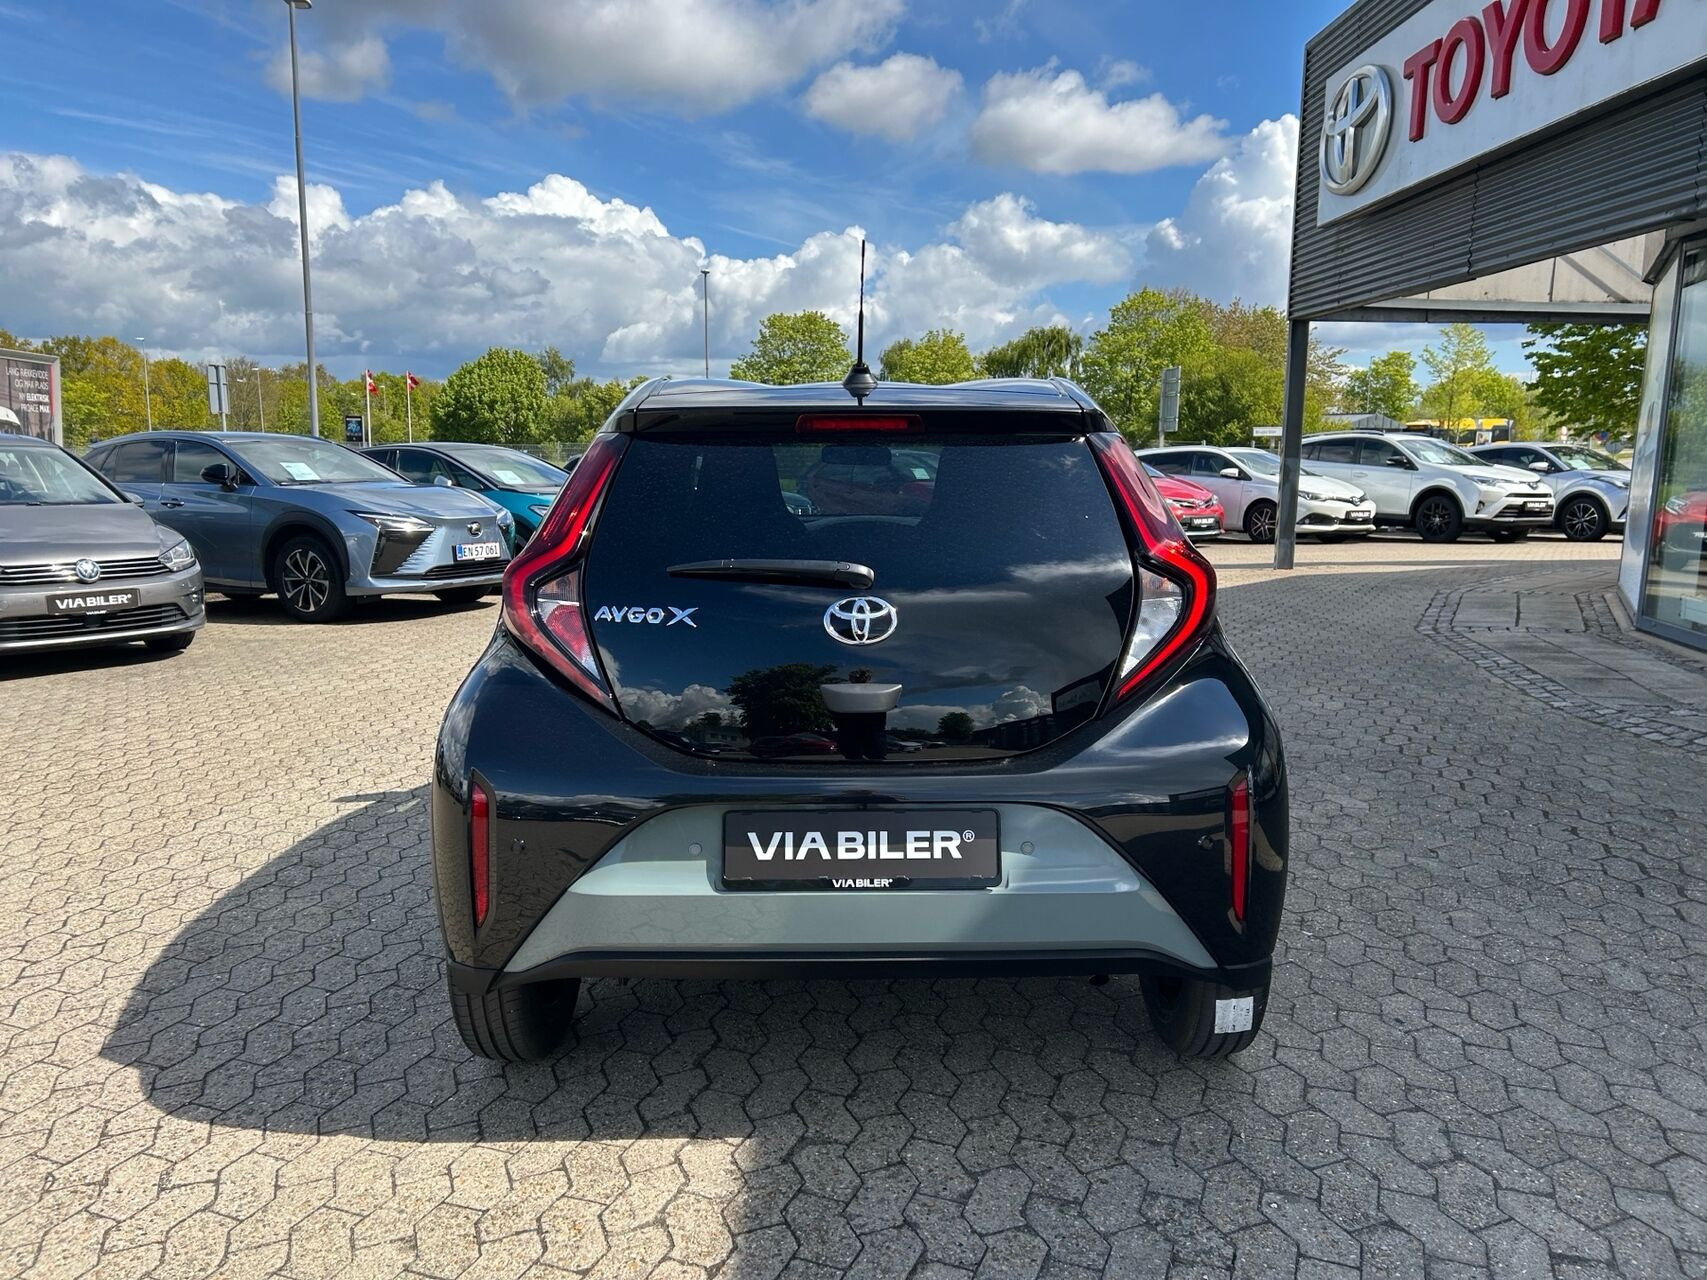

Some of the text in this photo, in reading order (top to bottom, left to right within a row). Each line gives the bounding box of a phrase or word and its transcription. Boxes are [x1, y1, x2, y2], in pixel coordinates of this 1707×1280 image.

[1403, 0, 1663, 142] TOYO
[15, 379, 23, 388] OG
[463, 545, 498, 557] EN 57 061
